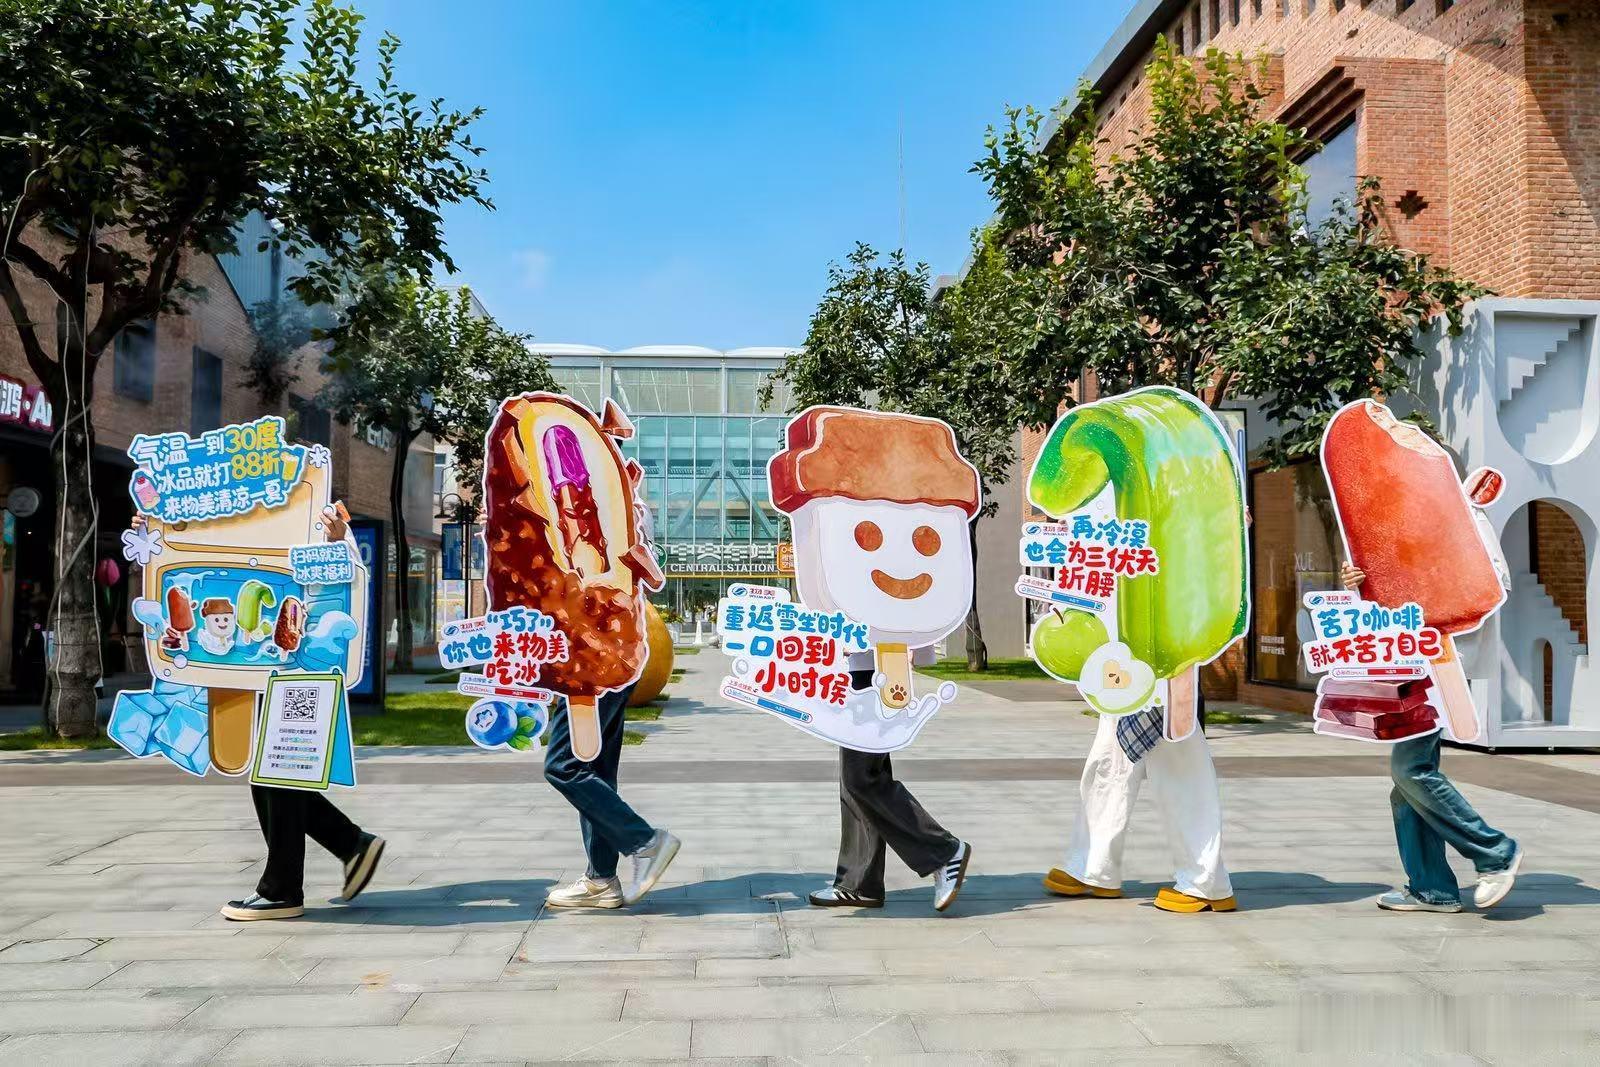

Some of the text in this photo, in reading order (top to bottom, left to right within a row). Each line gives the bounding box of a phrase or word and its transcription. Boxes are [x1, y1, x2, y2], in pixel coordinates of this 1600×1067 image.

[134, 419, 280, 471] 气温一到30度
[156, 452, 280, 494] 冰品就打88折
[164, 479, 283, 517] 来物美清凉一夏
[1071, 515, 1148, 549] 再冷漠
[292, 548, 349, 565] 扫码就送
[296, 563, 353, 581] 冰爽福利
[670, 564, 775, 573] CENTRAL STATION
[1024, 538, 1157, 575] 也会为三伏天
[1058, 566, 1115, 598] 折腰
[1317, 604, 1422, 638] 苦了咖啡
[443, 632, 566, 663] 你也来物美
[726, 635, 835, 666] 一口回到
[1309, 630, 1440, 667] 就不苦了自己
[486, 658, 538, 685] 吃冰
[755, 661, 850, 705] 小时候
